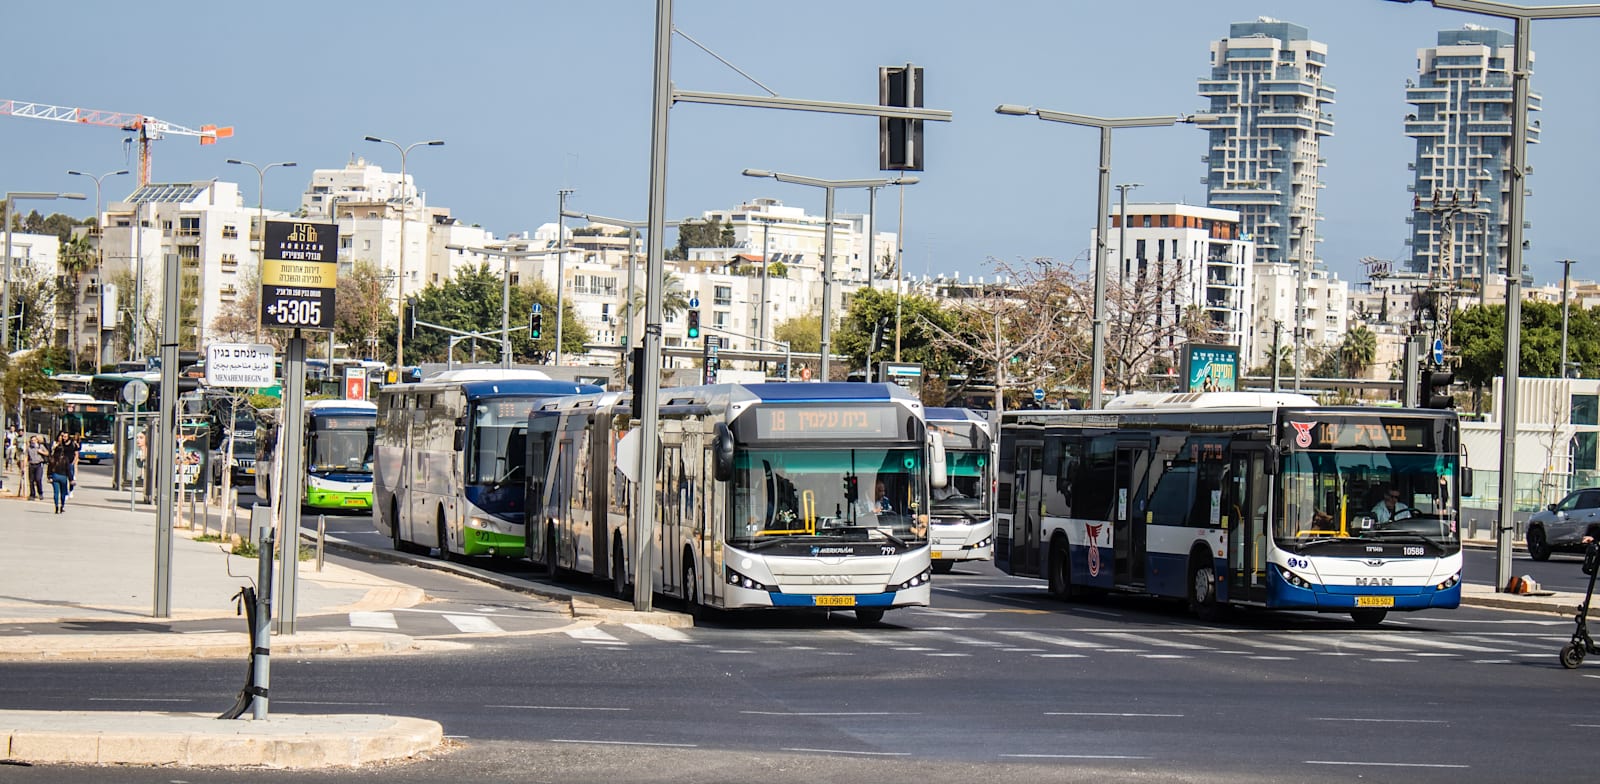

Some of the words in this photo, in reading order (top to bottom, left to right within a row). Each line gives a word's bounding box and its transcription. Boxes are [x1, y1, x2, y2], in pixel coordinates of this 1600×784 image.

[280, 242, 324, 250] HORIZON
[280, 274, 300, 282] והשכרה
[302, 275, 321, 283] למכירה
[214, 349, 230, 359] בגין
[234, 349, 256, 358] מנחם
[252, 363, 268, 371] طريق
[215, 374, 242, 382] MENAHEM
[771, 410, 785, 431] 18
[842, 412, 868, 427] בית
[1320, 424, 1338, 443] 161
[1355, 424, 1383, 442] ברק
[1386, 425, 1406, 440] בני
[881, 547, 895, 555] 799
[1404, 547, 1424, 555] 10588
[812, 575, 852, 584] MAN
[1356, 578, 1393, 586] MAN
